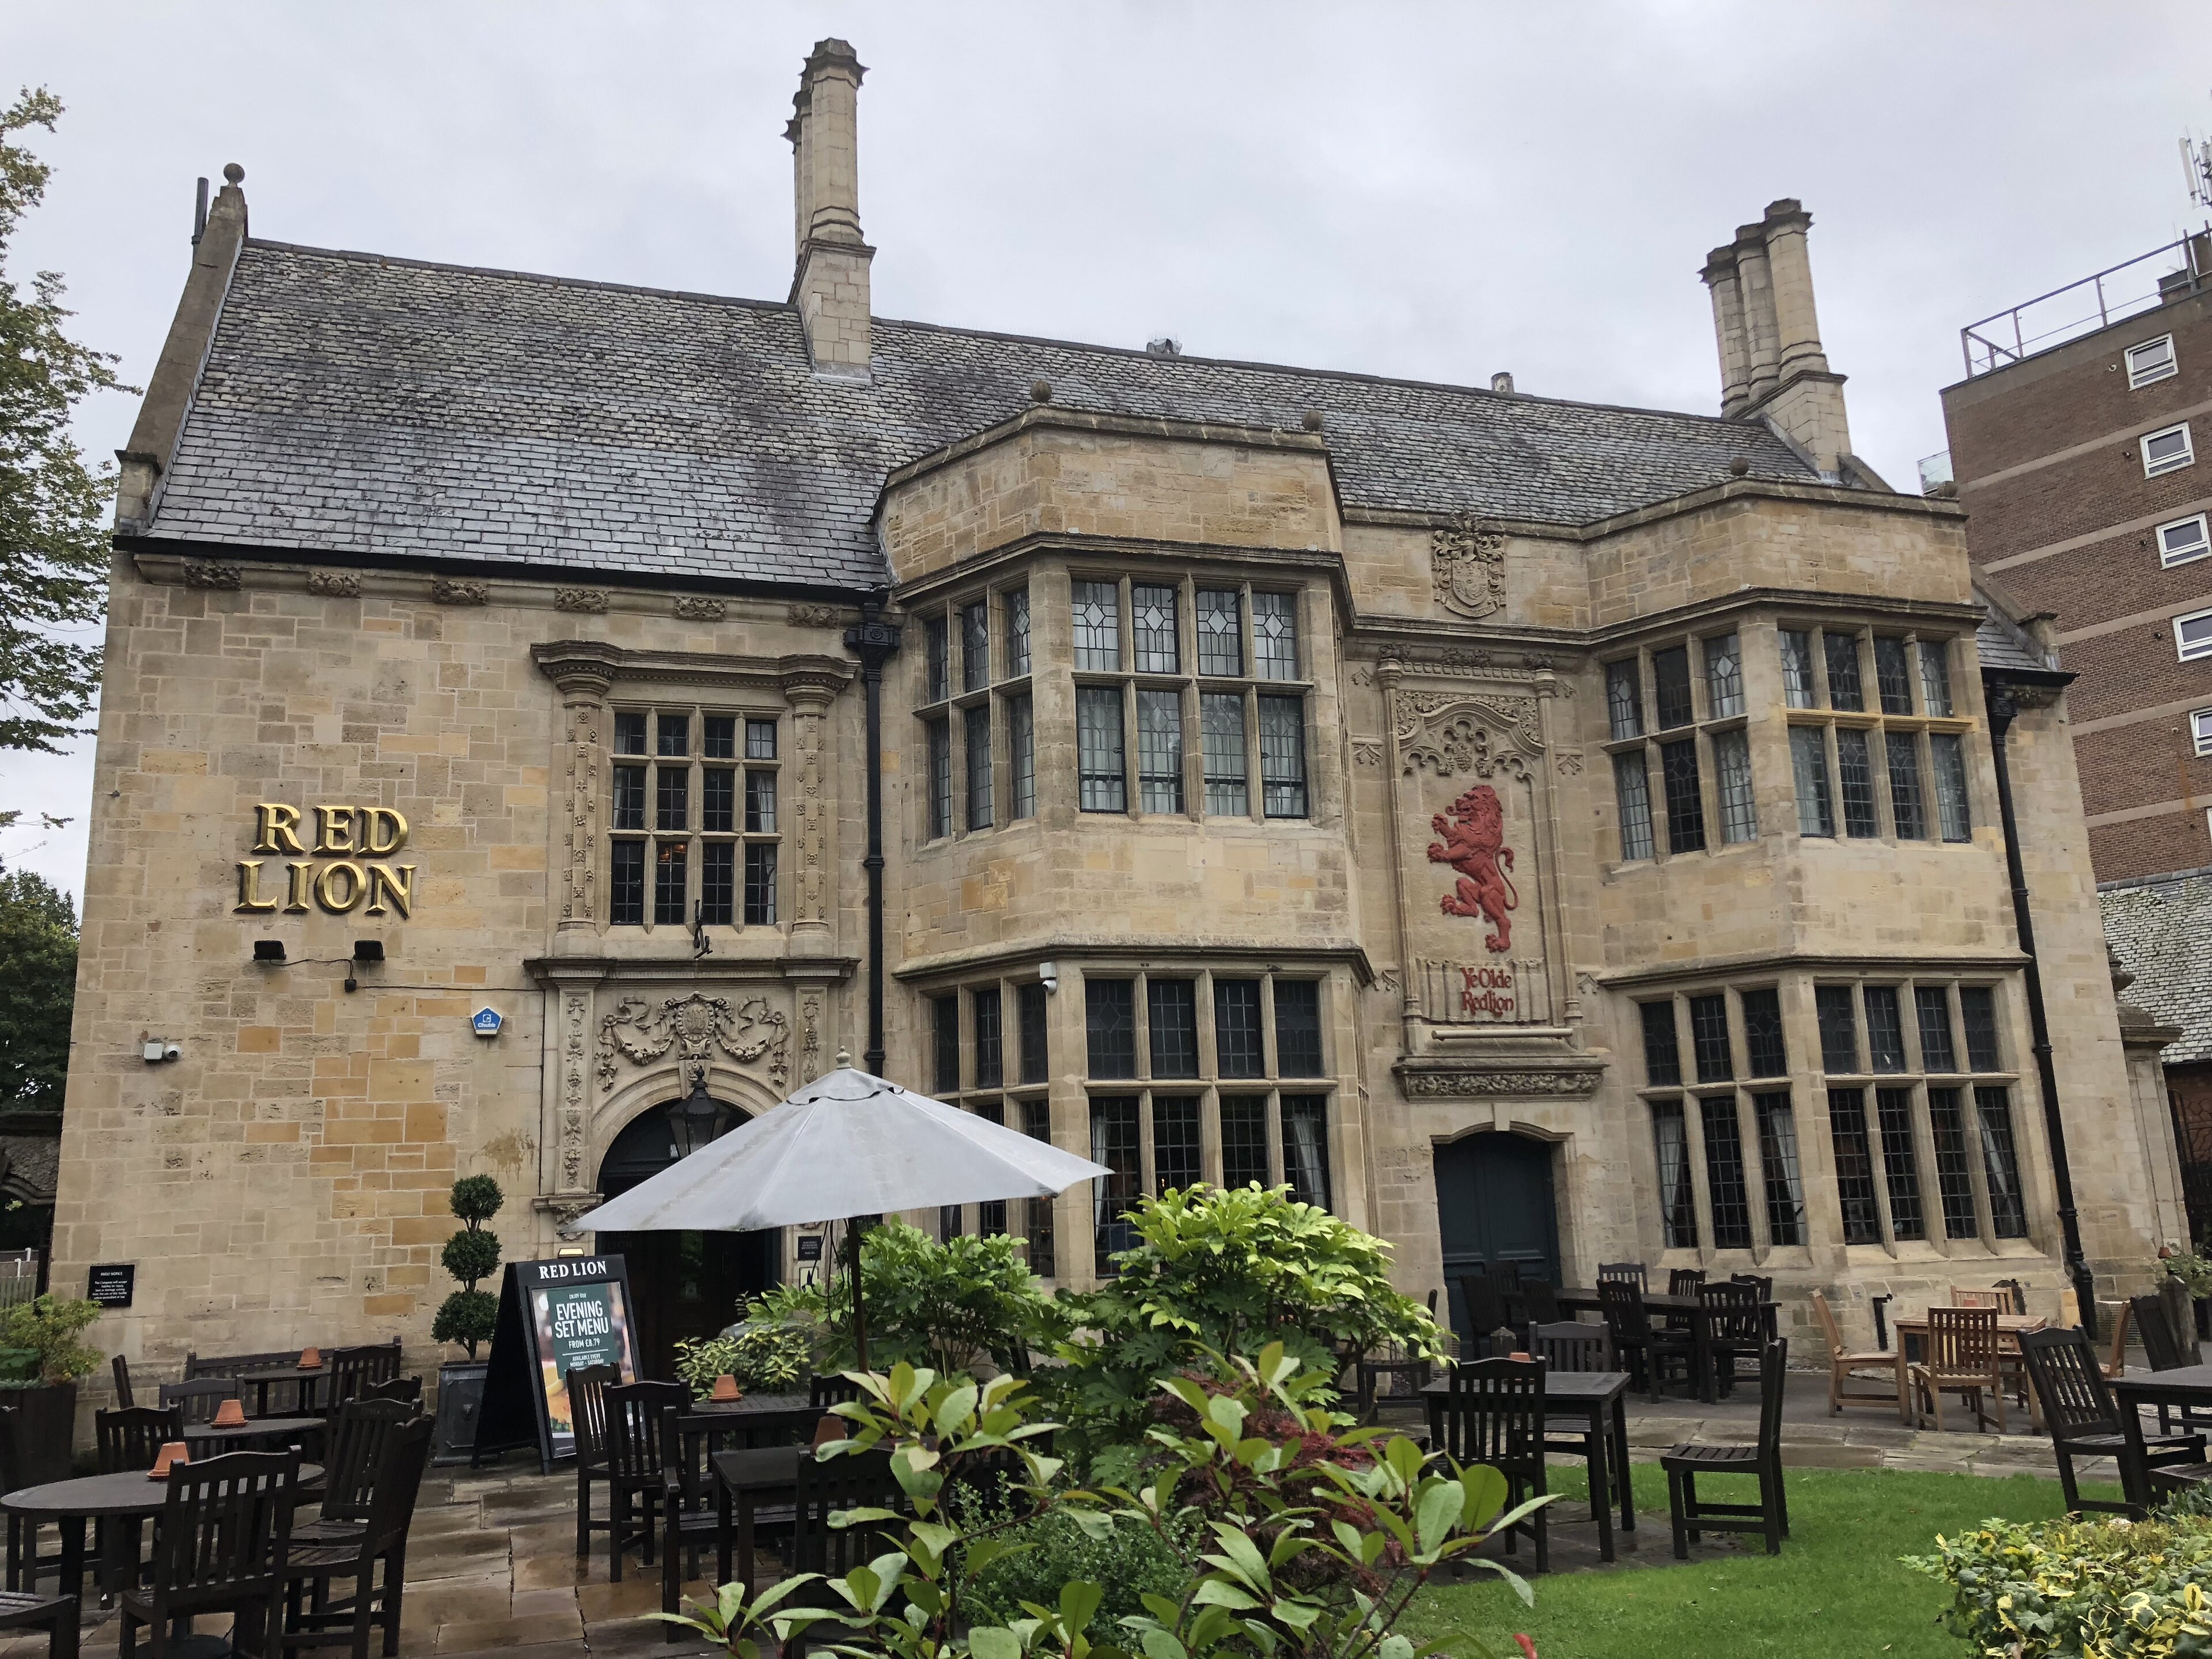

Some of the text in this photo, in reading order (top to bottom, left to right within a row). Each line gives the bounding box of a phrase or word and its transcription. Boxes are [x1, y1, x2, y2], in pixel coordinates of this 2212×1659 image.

[252, 803, 408, 855] RED
[233, 860, 418, 919] LION
[1461, 967, 1512, 990] Ye Olde
[539, 1260, 607, 1279] RED LION
[556, 1300, 603, 1321] EVENING
[554, 1317, 609, 1339] SET MENU
[569, 1338, 600, 1349] FROM £8.79
